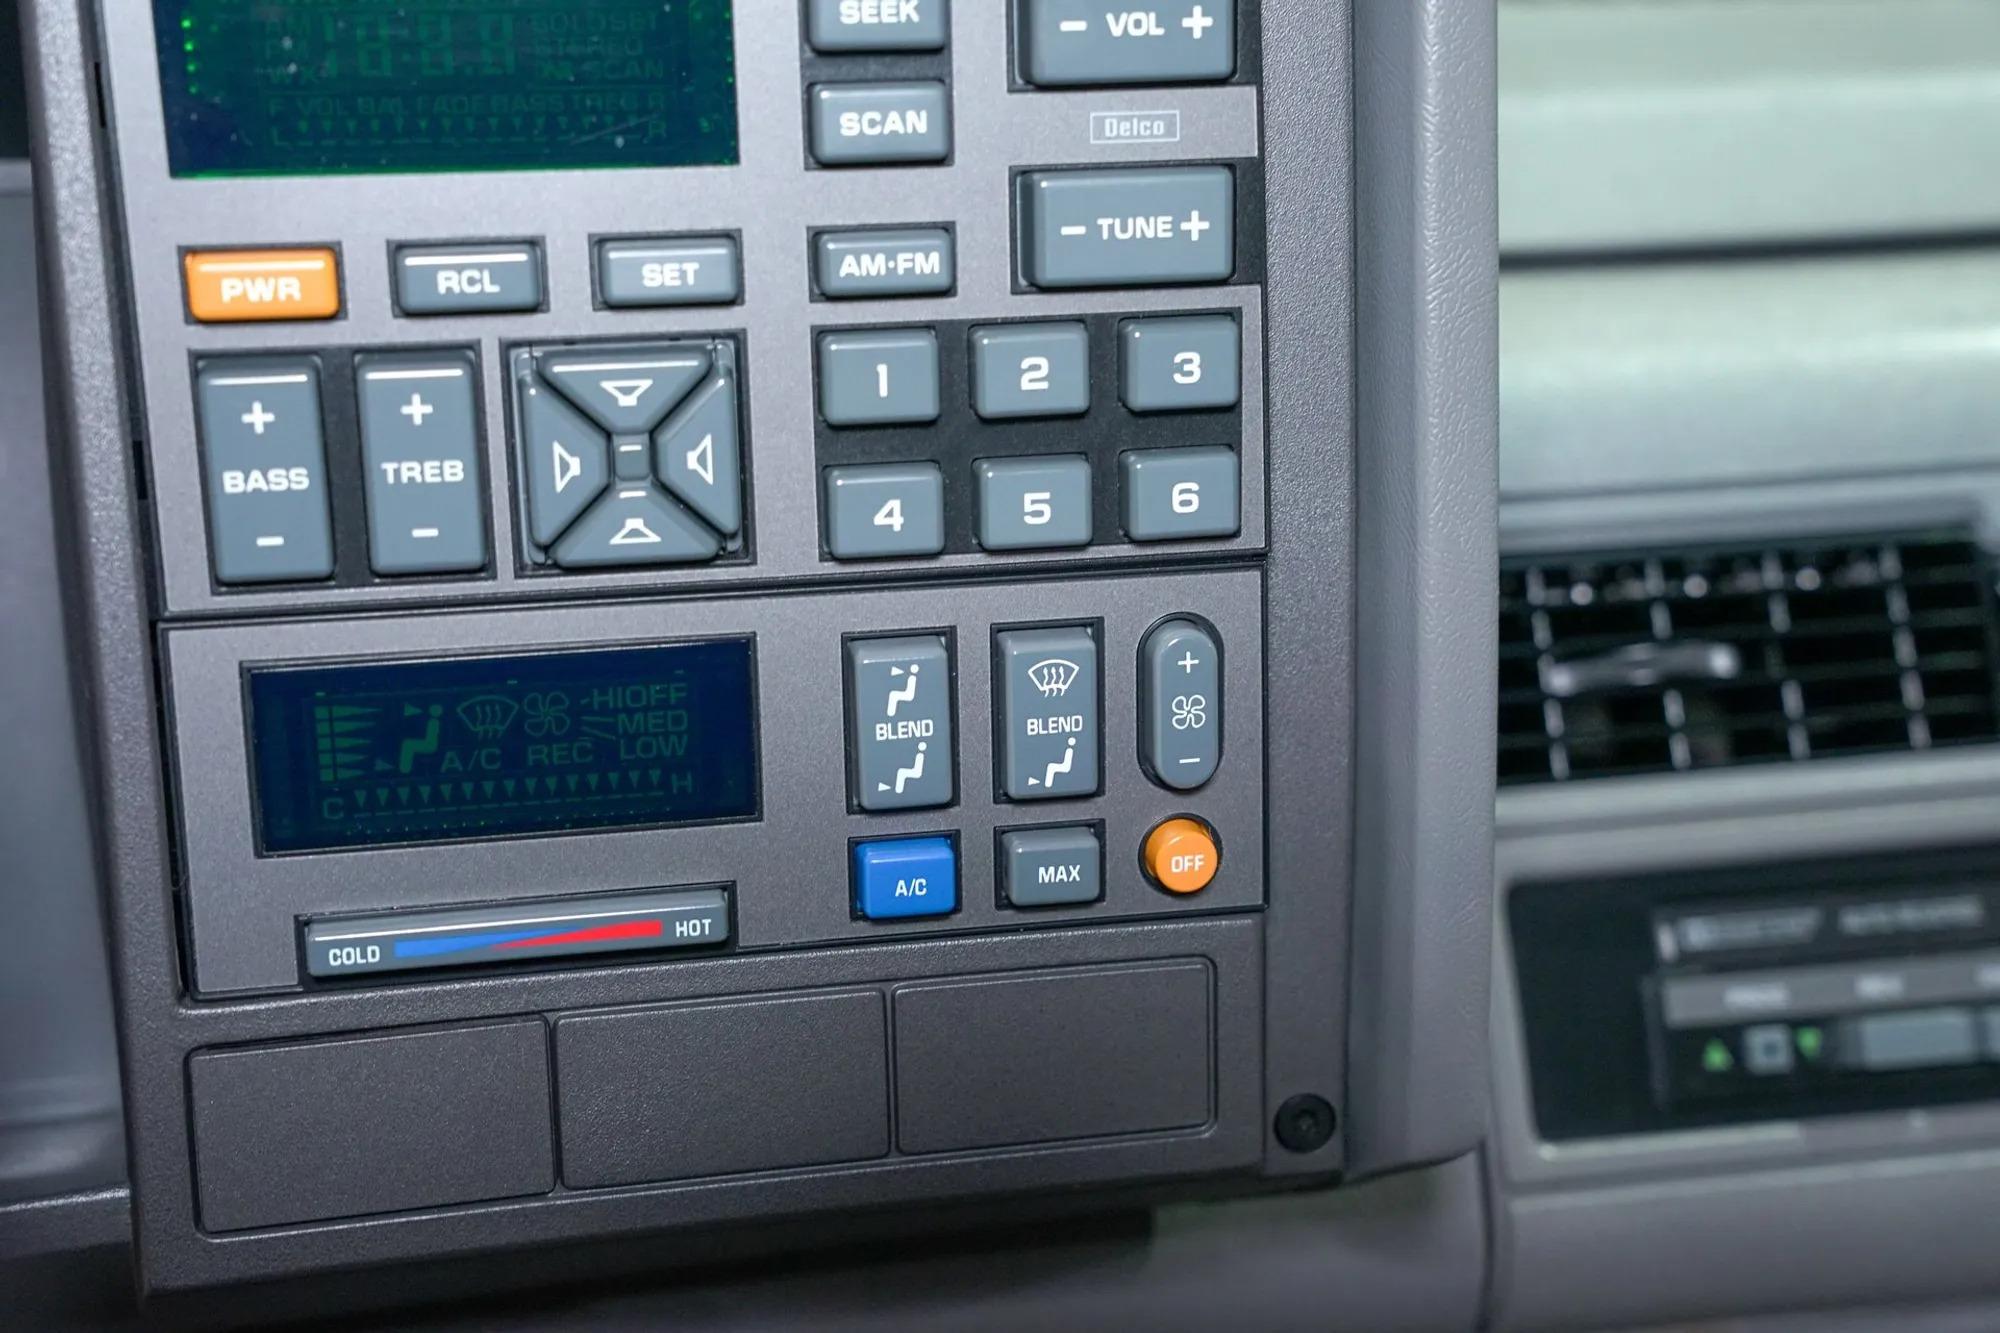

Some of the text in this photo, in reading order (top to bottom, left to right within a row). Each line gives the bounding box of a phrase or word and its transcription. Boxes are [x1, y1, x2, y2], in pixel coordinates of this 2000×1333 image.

[840, 0, 919, 24] SEEK
[1106, 12, 1164, 36] VOL
[840, 111, 927, 136] SCAN
[1105, 117, 1165, 137] Delco
[1097, 216, 1172, 239] TUNE
[437, 270, 499, 293] RCL
[642, 263, 699, 286] SET
[222, 277, 300, 301] PWR
[1021, 357, 1048, 390] 2
[1174, 352, 1200, 383] 3
[877, 364, 887, 397] 1
[223, 468, 309, 493] BASS
[382, 460, 464, 483] TREB
[1024, 492, 1051, 524] 5
[1172, 483, 1199, 513] 6
[874, 500, 903, 531] 4
[617, 711, 689, 735] MED
[876, 720, 933, 740] BLEND
[1028, 716, 1082, 735] BLEND
[527, 743, 593, 768] REC
[619, 736, 689, 762] LOW
[440, 750, 502, 775] A/C
[1039, 865, 1080, 883] MAX
[1172, 855, 1203, 872] OFF
[896, 879, 926, 896] A/C
[329, 919, 711, 965] COLD HOT
